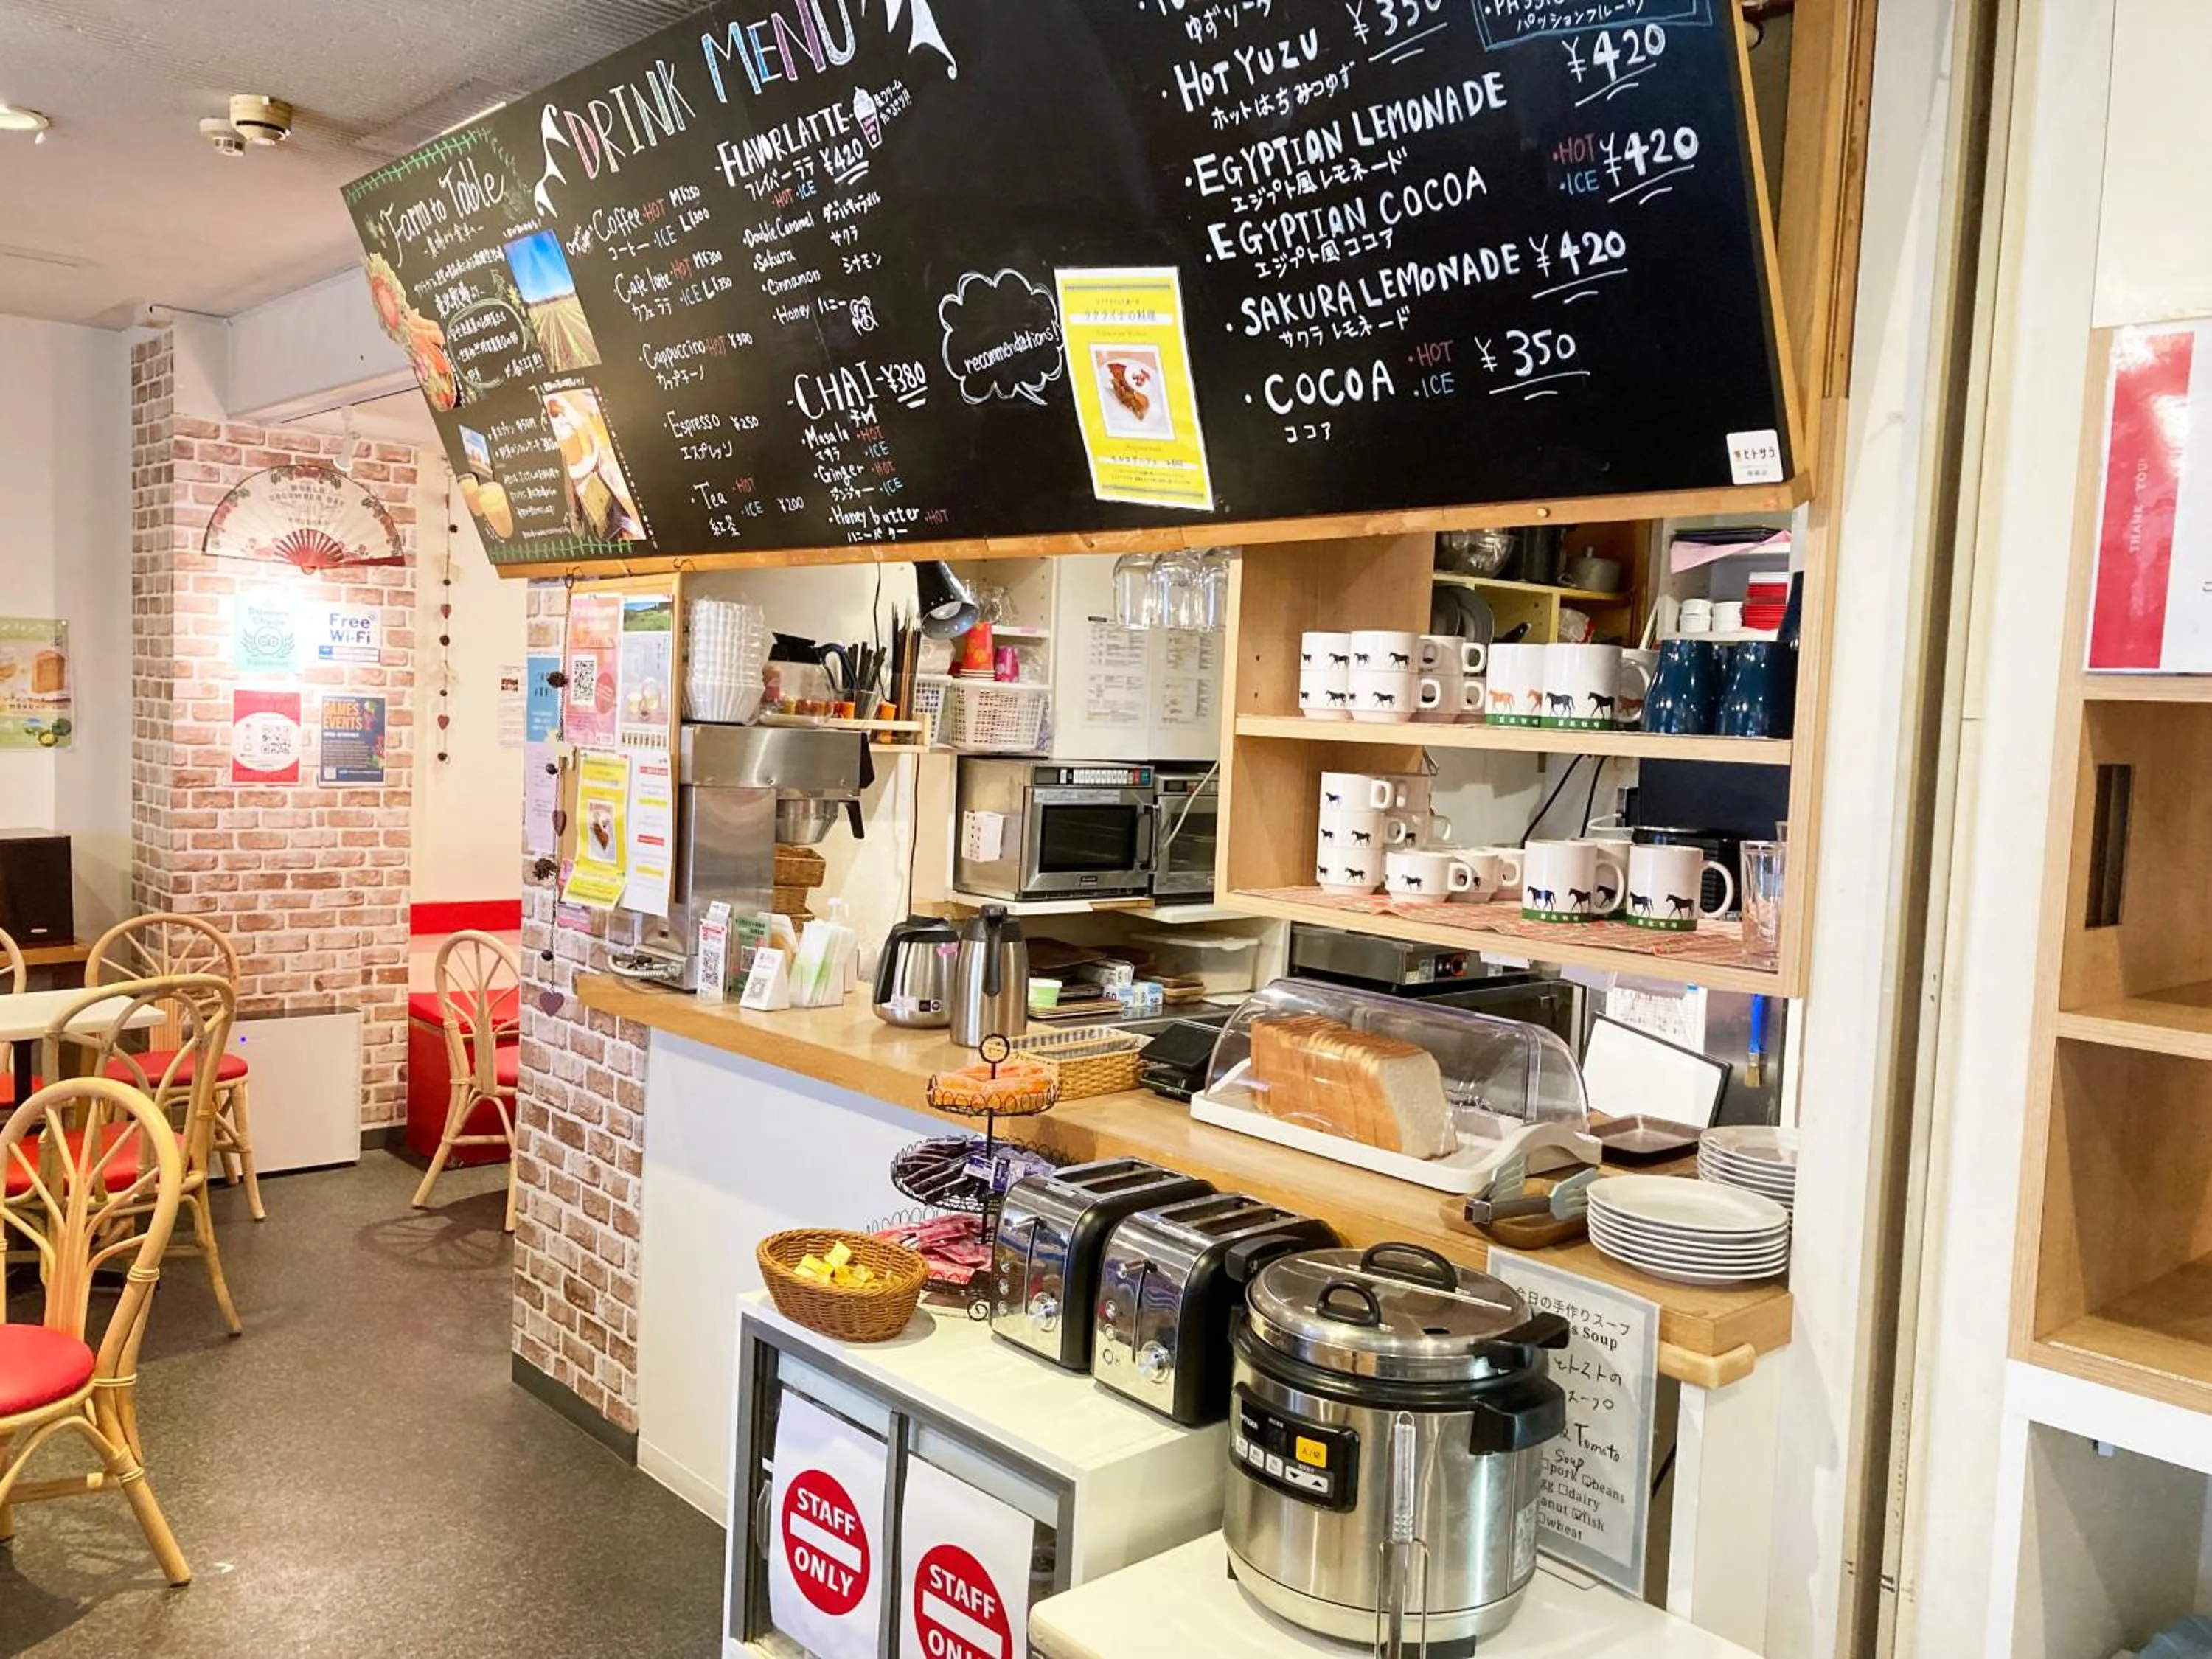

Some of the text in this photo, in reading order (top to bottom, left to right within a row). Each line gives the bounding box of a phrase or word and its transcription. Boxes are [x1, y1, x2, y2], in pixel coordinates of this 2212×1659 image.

[1234, 28, 1319, 86] YUZU
[1562, 23, 1666, 83] ¥420
[564, 0, 856, 180] DRINK MENU
[1211, 61, 1356, 130] ホットはちみつゆず
[782, 102, 849, 153] LATTE
[1193, 72, 1508, 196] EGYPTIAN LEMONADE
[819, 138, 864, 176] ¥420
[1558, 133, 1596, 163] HOT
[1567, 127, 1698, 194] ICE ¥420
[439, 157, 504, 219] Table
[774, 181, 817, 208] HOT ICE
[1231, 147, 1408, 213] エジプト風レモネード
[592, 207, 643, 242] Coffee
[644, 198, 666, 223] HOT
[1207, 166, 1486, 260] EGYPTIAN COCOA
[655, 225, 678, 248] ICE
[745, 210, 814, 248] Double Caramel
[830, 225, 858, 246] サクラ
[754, 249, 796, 272] Sakura
[841, 252, 881, 274] シナモン
[1254, 228, 1394, 279] エジプト風ココア
[615, 272, 648, 304] Cafe
[672, 257, 692, 279] HOT
[681, 284, 703, 307] ICE
[767, 269, 821, 296] Cinnamon
[1241, 229, 1626, 336] SAKURA LEMONADE ¥420
[776, 304, 810, 325] Honey
[818, 297, 846, 314] ハニー
[642, 339, 706, 369] Cappuccino
[706, 336, 727, 357] HOT
[1416, 330, 1576, 378] HOT ¥350
[794, 361, 925, 420] CHAI ¥380
[1265, 359, 1395, 415] COCOA
[1422, 372, 1455, 398] ICE
[666, 410, 720, 438] Espresso
[804, 421, 885, 449] Masala HOT
[1285, 422, 1332, 443] ココア
[868, 441, 890, 458] ICE
[1744, 446, 1775, 459] ヒトサラ
[817, 461, 896, 487] Ginger HOT
[883, 477, 904, 496] ICE
[693, 478, 756, 509] Tea HOT
[744, 496, 804, 517] ICE ¥200
[831, 504, 949, 529] Honey butter HOT
[2129, 502, 2145, 554] THANK
[329, 613, 370, 629] Free
[330, 629, 371, 644] Wi-Fi
[322, 716, 363, 730] EVENTS
[1582, 1327, 1617, 1352] Soup
[1574, 1423, 1621, 1462] Tomato
[1555, 1448, 1585, 1473] Soup
[1568, 1488, 1601, 1512] dairy
[1593, 1478, 1625, 1503] beans
[797, 1487, 855, 1537] STAFF
[1540, 1497, 1604, 1531] anut fish
[1546, 1517, 1582, 1540] wheat
[794, 1546, 854, 1597] ONLY
[930, 1564, 996, 1620] STAFF
